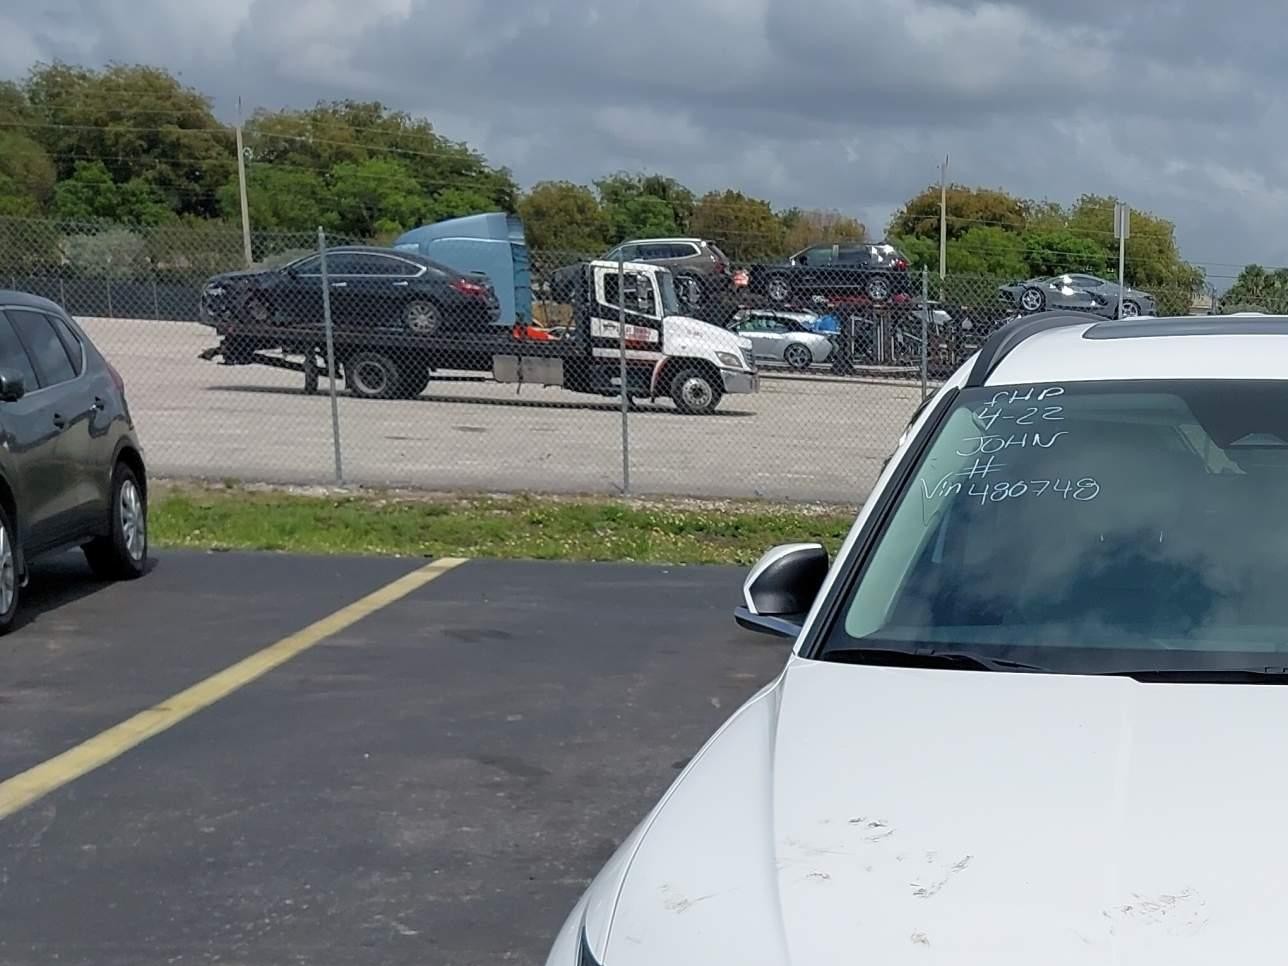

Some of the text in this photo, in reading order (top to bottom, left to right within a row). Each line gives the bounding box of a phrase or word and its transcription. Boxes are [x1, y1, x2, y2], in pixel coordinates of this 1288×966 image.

[978, 406, 1065, 431] 4-22
[956, 431, 1069, 455] JOHN
[968, 478, 1100, 505] 480748
